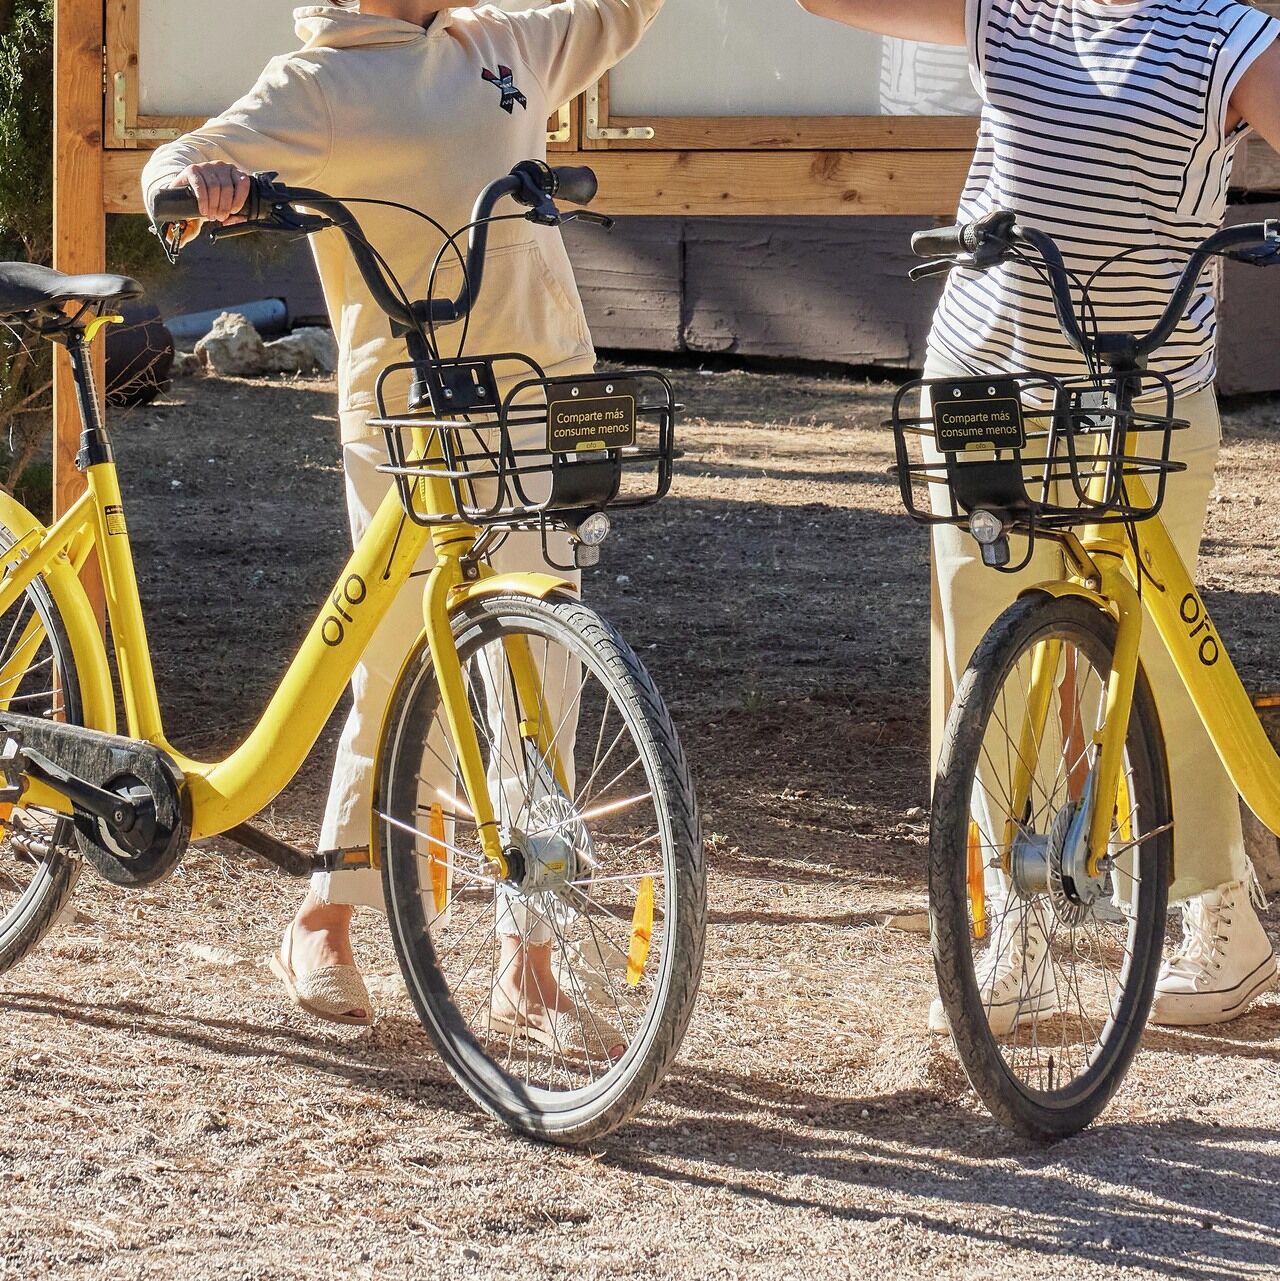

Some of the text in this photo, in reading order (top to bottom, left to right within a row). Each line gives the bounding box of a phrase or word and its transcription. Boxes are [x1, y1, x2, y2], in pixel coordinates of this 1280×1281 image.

[556, 407, 624, 424] Comparte más
[942, 409, 1010, 425] Comparte más
[553, 423, 630, 438] consume menos
[941, 425, 1018, 438] consume menos
